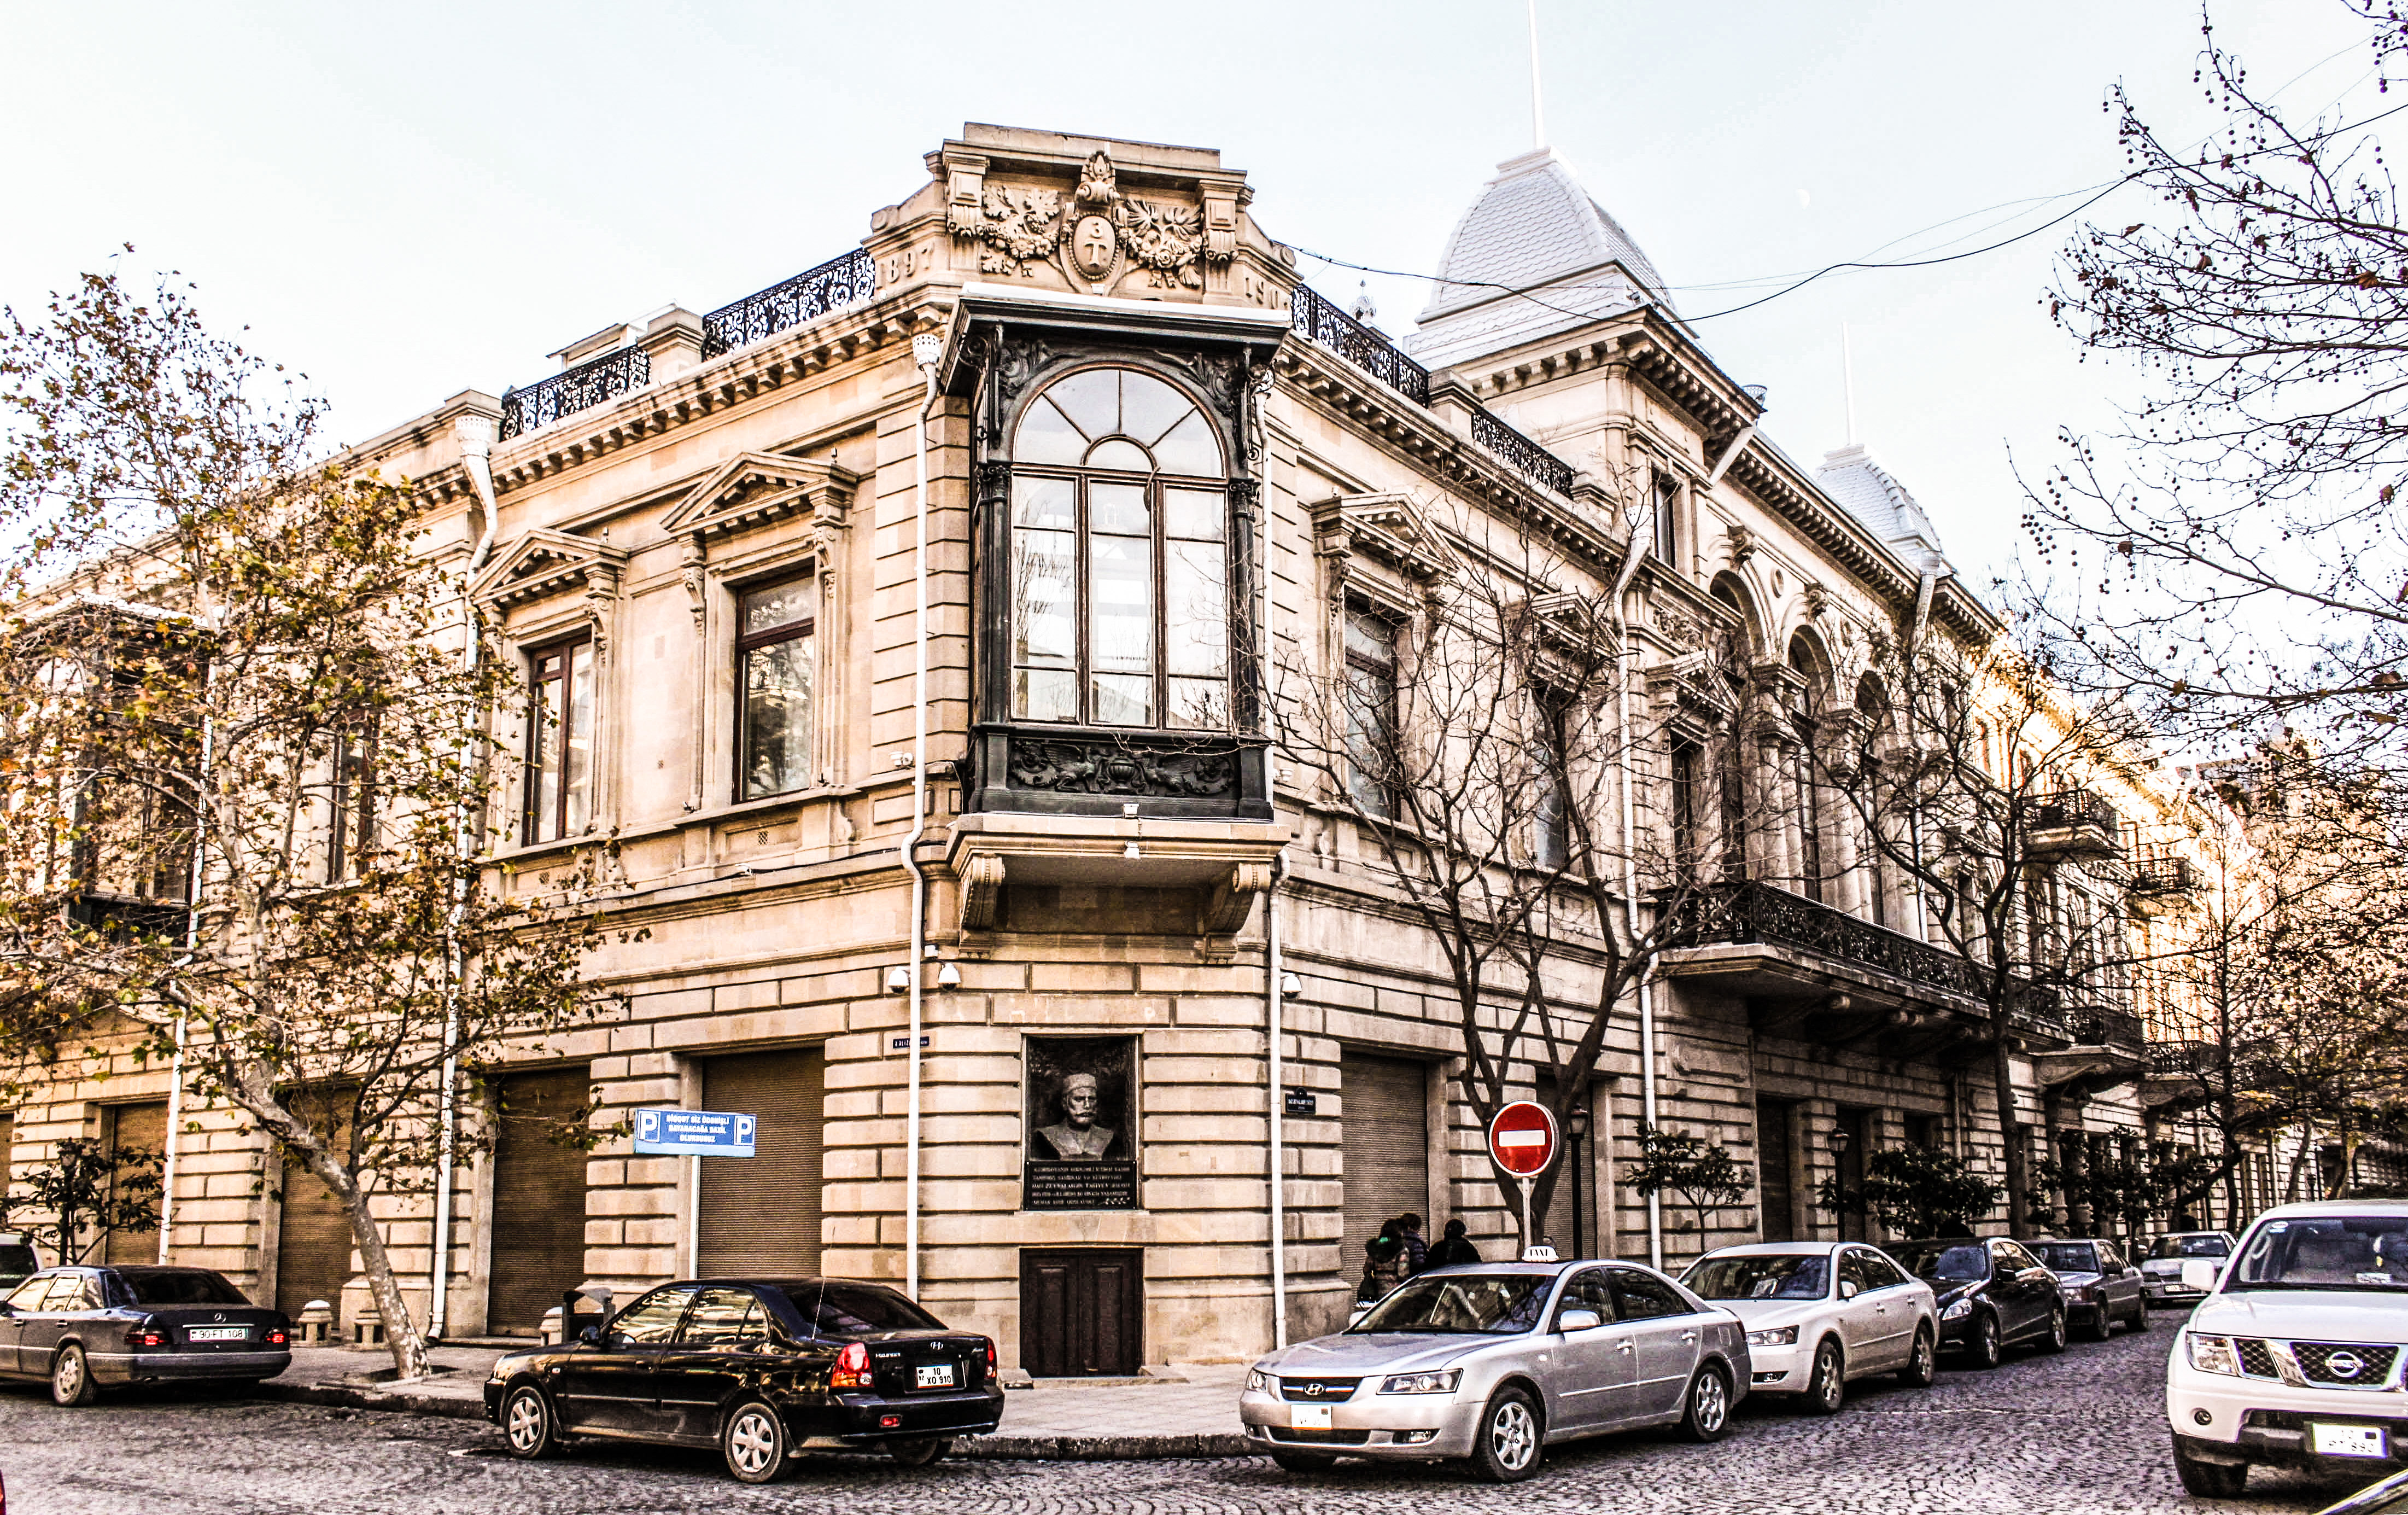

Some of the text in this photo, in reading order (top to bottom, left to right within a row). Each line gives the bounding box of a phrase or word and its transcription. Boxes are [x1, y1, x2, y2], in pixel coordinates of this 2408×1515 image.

[875, 241, 934, 290] 1897
[229, 1329, 243, 1338] 108
[933, 1367, 941, 1376] 10
[939, 1375, 951, 1384] 910
